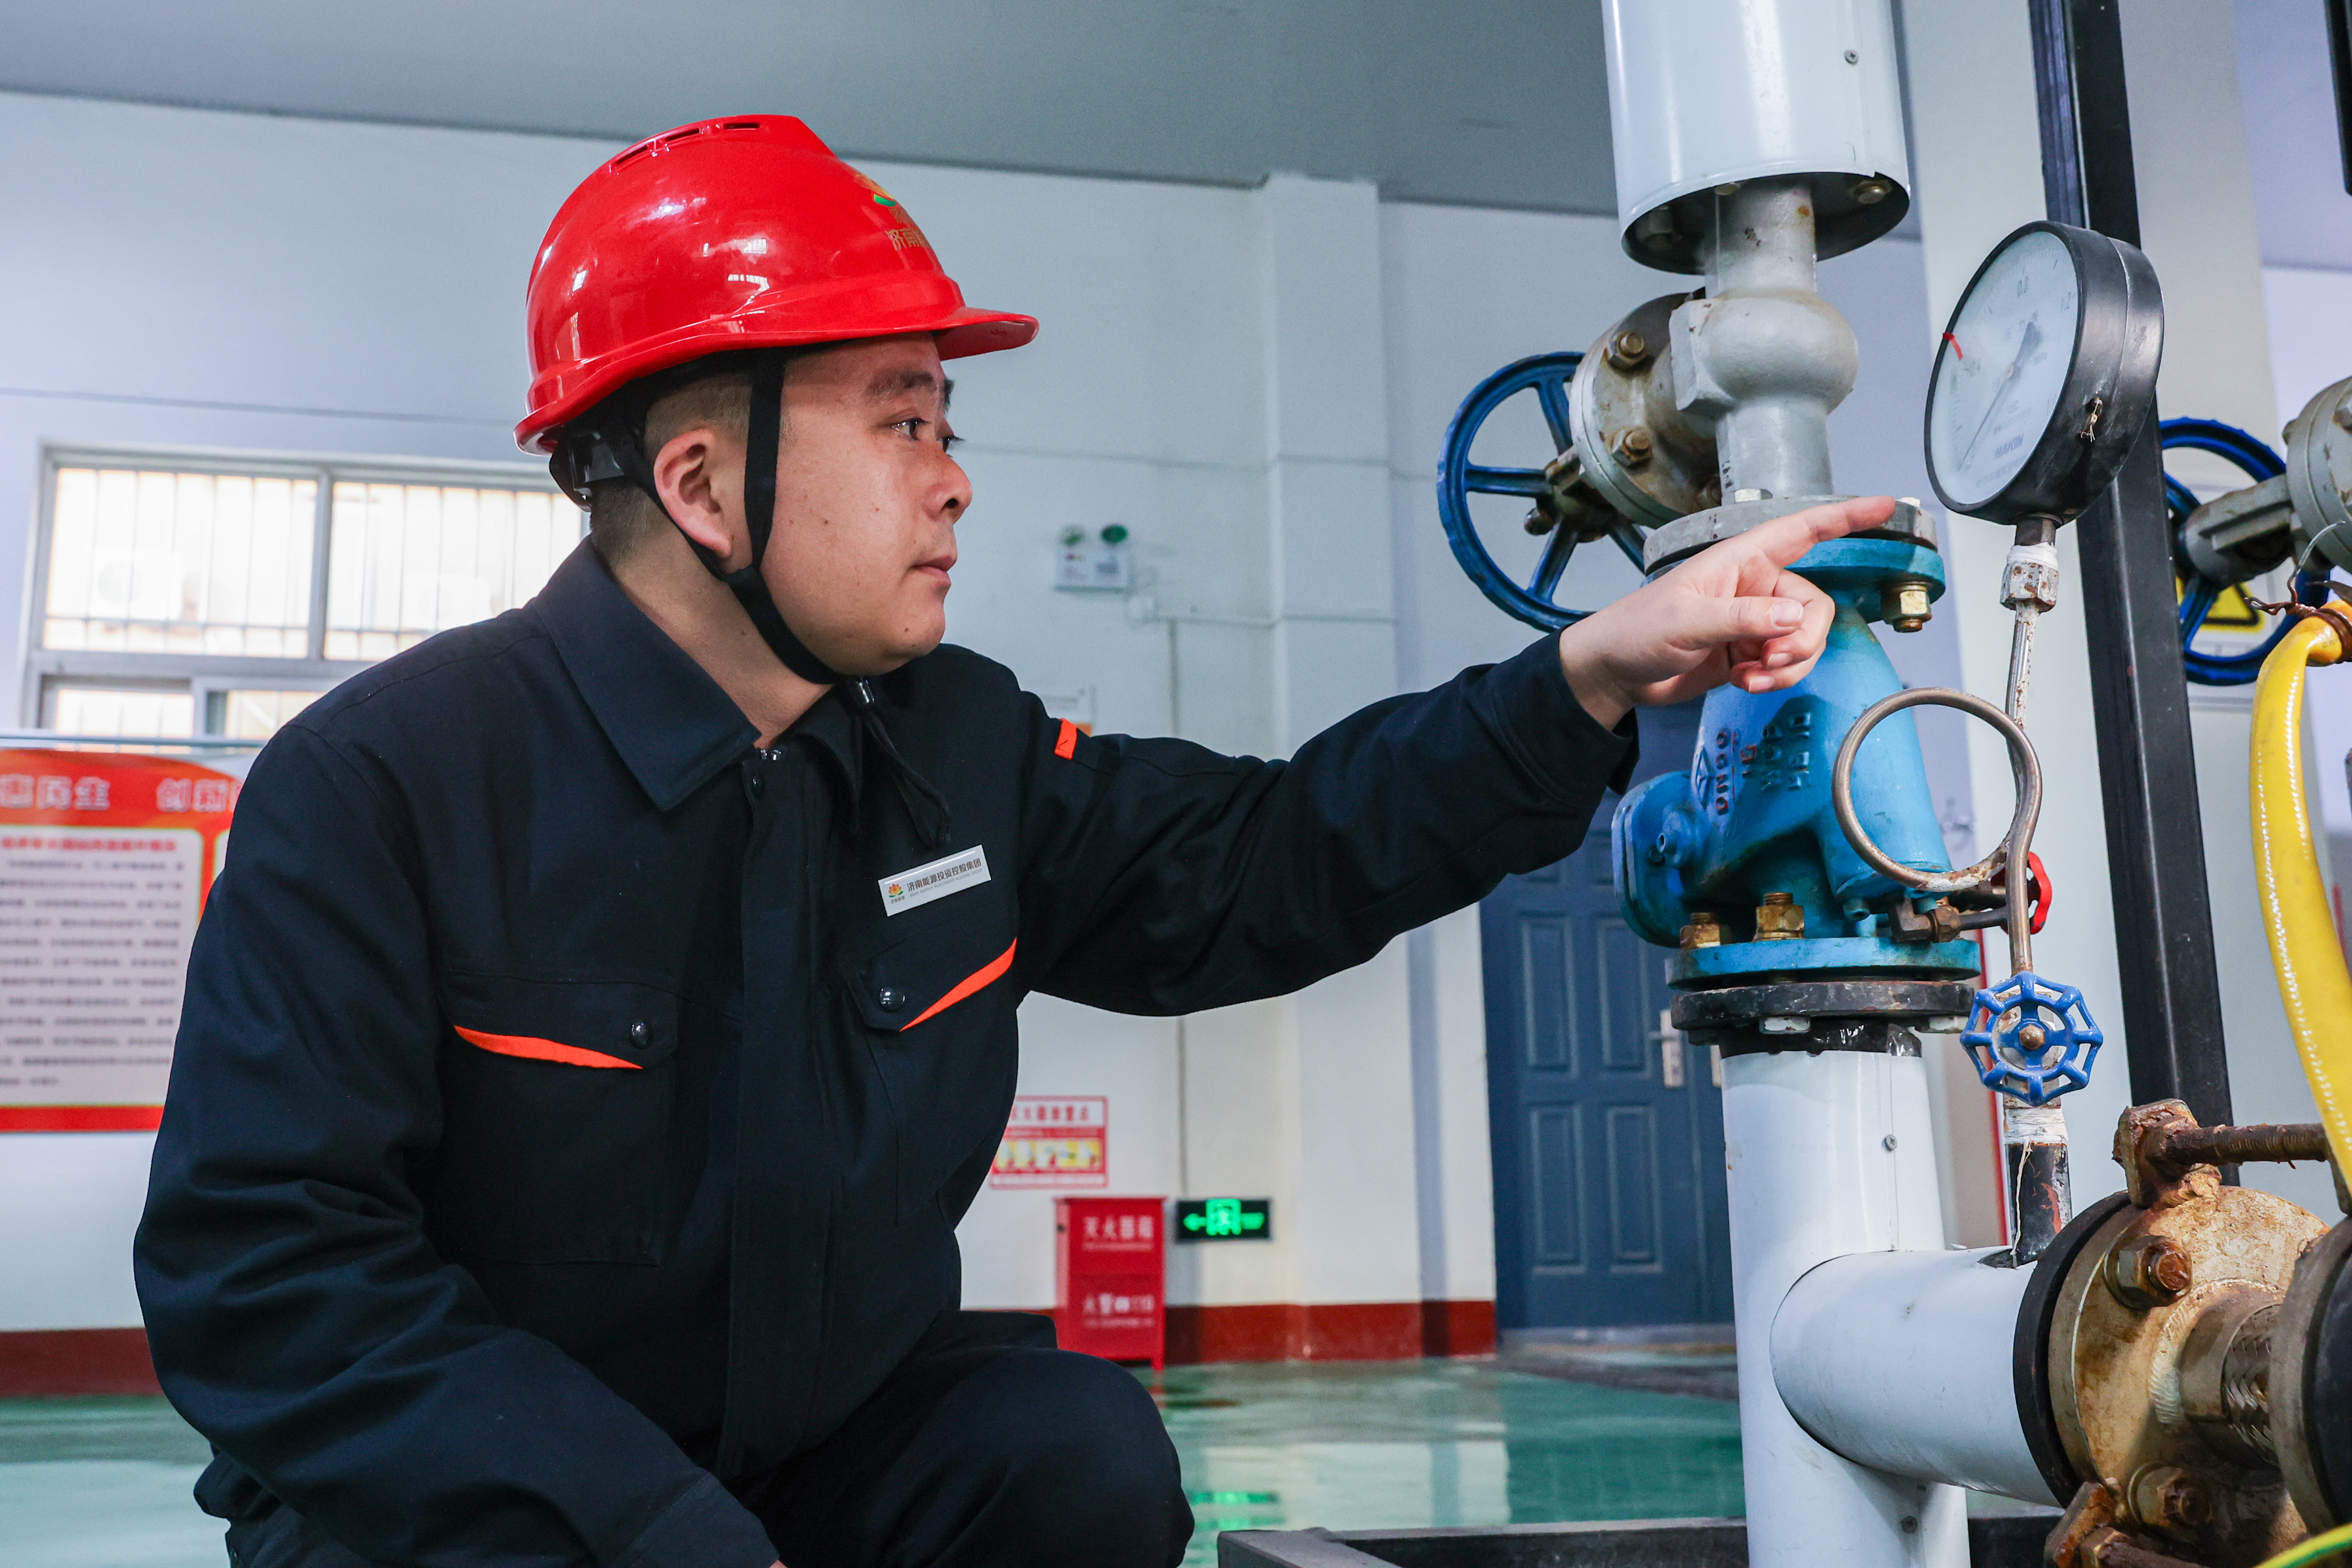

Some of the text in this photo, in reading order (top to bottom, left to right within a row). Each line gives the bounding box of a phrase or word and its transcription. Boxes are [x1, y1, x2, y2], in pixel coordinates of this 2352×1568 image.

[2061, 291, 2072, 314] 1.2
[906, 858, 981, 892] 济南能源投资控股集团
[920, 886, 933, 894] ENERGY
[934, 878, 955, 889] INVESTMENT
[955, 873, 971, 881] HOLDING
